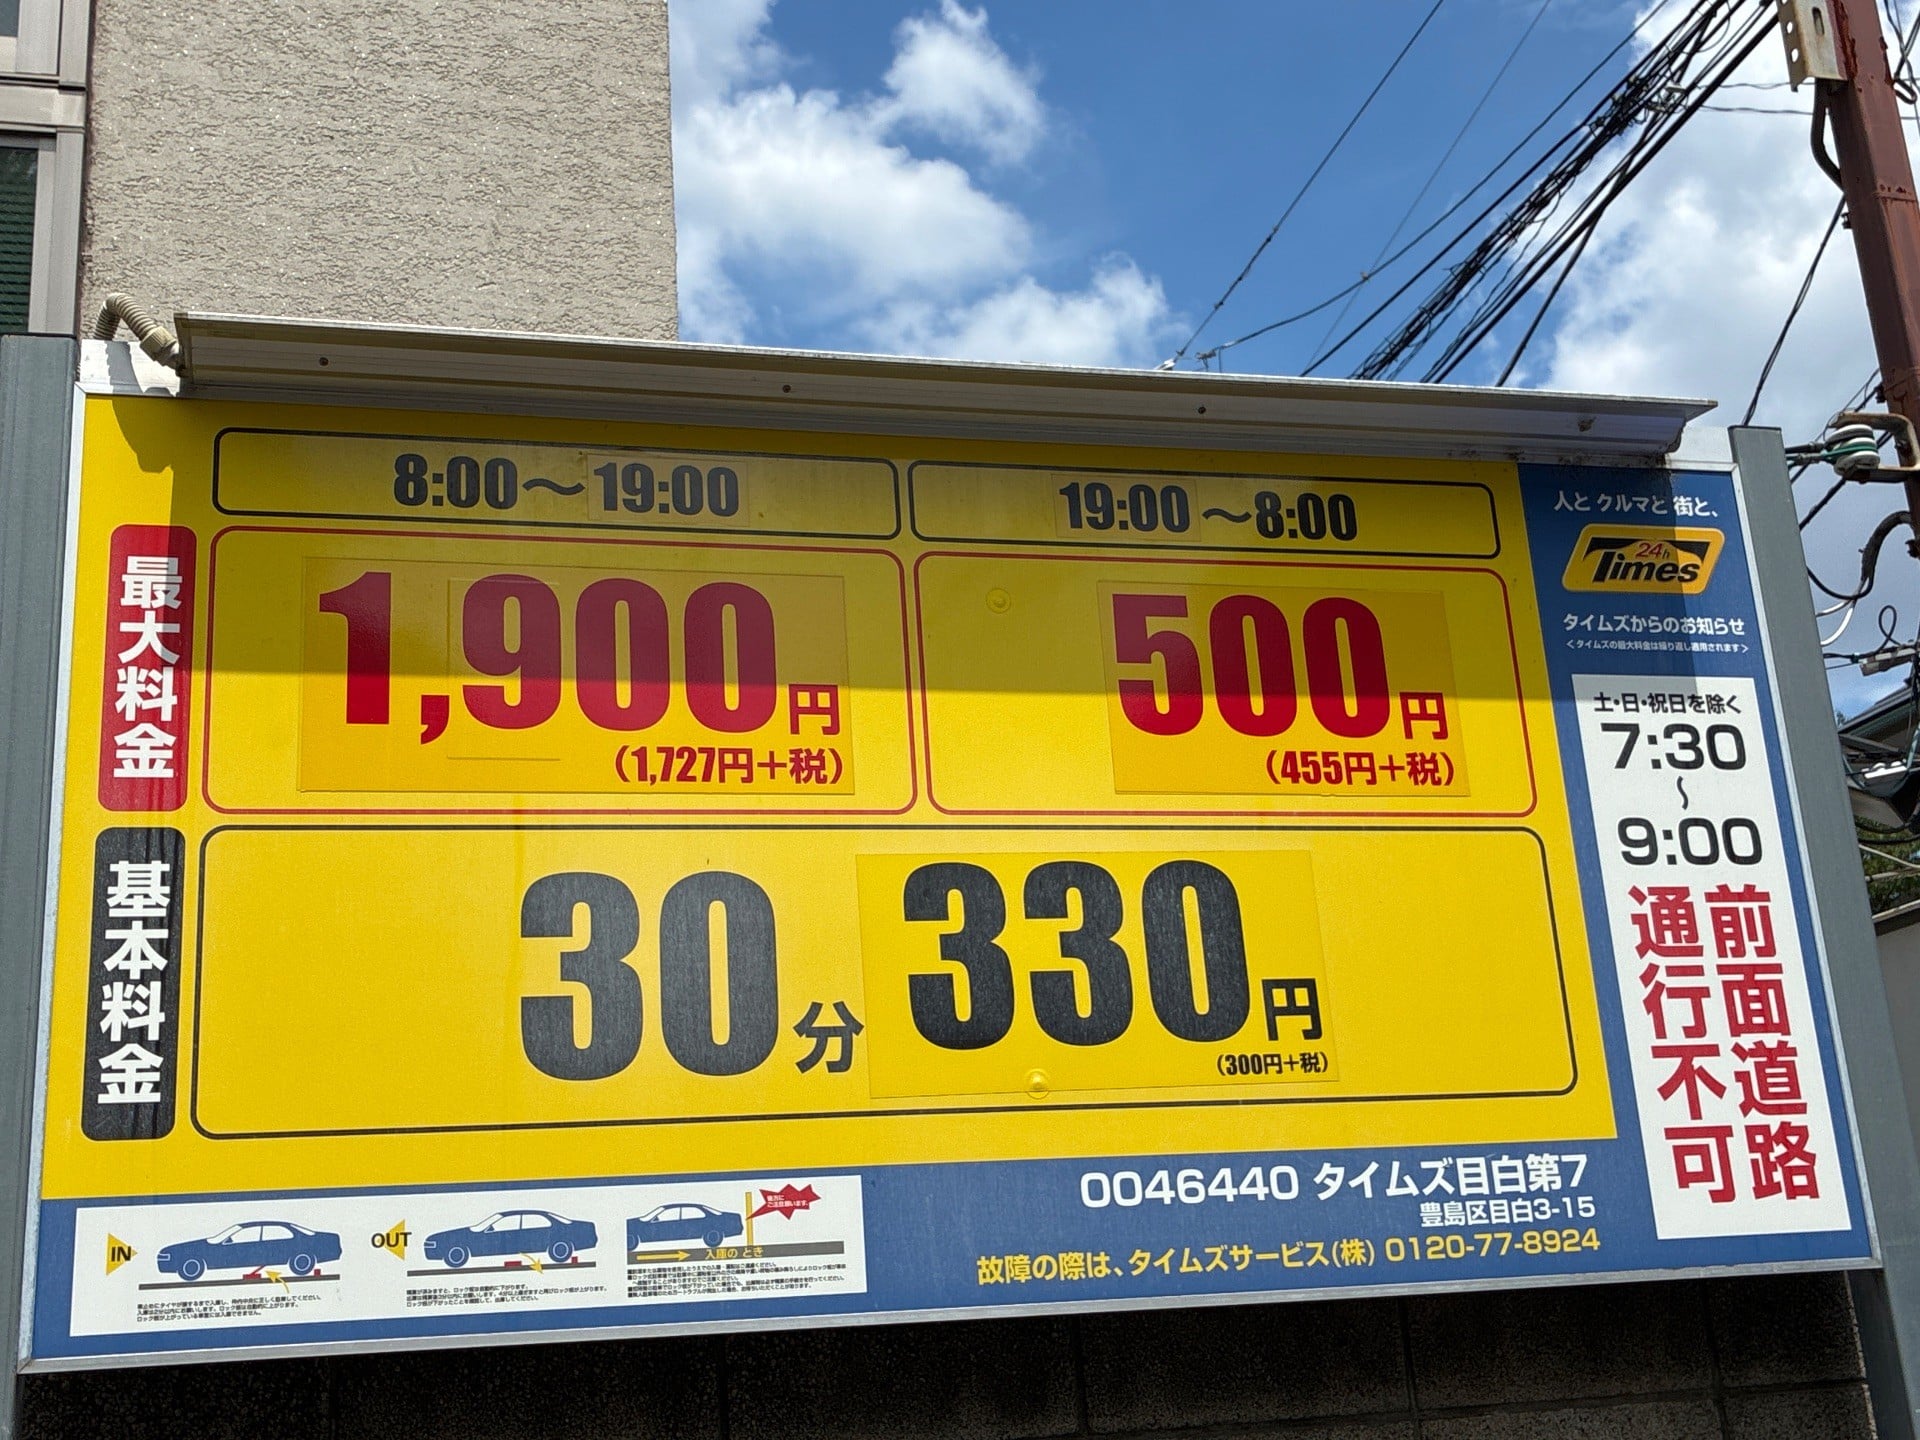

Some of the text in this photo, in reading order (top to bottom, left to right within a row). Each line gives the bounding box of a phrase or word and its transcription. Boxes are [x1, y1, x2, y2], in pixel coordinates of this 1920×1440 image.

[1553, 490, 1718, 517] 人と クルマと 街と、
[1586, 540, 1708, 583] Times
[1563, 613, 1745, 637] タイムズからのお知らせ
[113, 555, 183, 778] 最大料金
[319, 571, 840, 745] 1,900円
[1112, 593, 1449, 741] 500円
[1593, 691, 1742, 715] 土・日・祝日を除く
[1600, 722, 1747, 771] 7:30
[1617, 817, 1763, 866] 9:00
[97, 859, 171, 1104] 基本料金
[520, 859, 1324, 1081] 30分 330円
[1627, 884, 1737, 1204] 通行不可
[1704, 883, 1821, 1201] 前面道路
[1079, 1153, 1589, 1208] 0046440 タイムズ目白第7
[1419, 1198, 1596, 1229] 豊島区目白3-15
[110, 1246, 132, 1263] IN
[371, 1232, 412, 1249] OUT
[1384, 1227, 1601, 1265] 0120-77-8924
